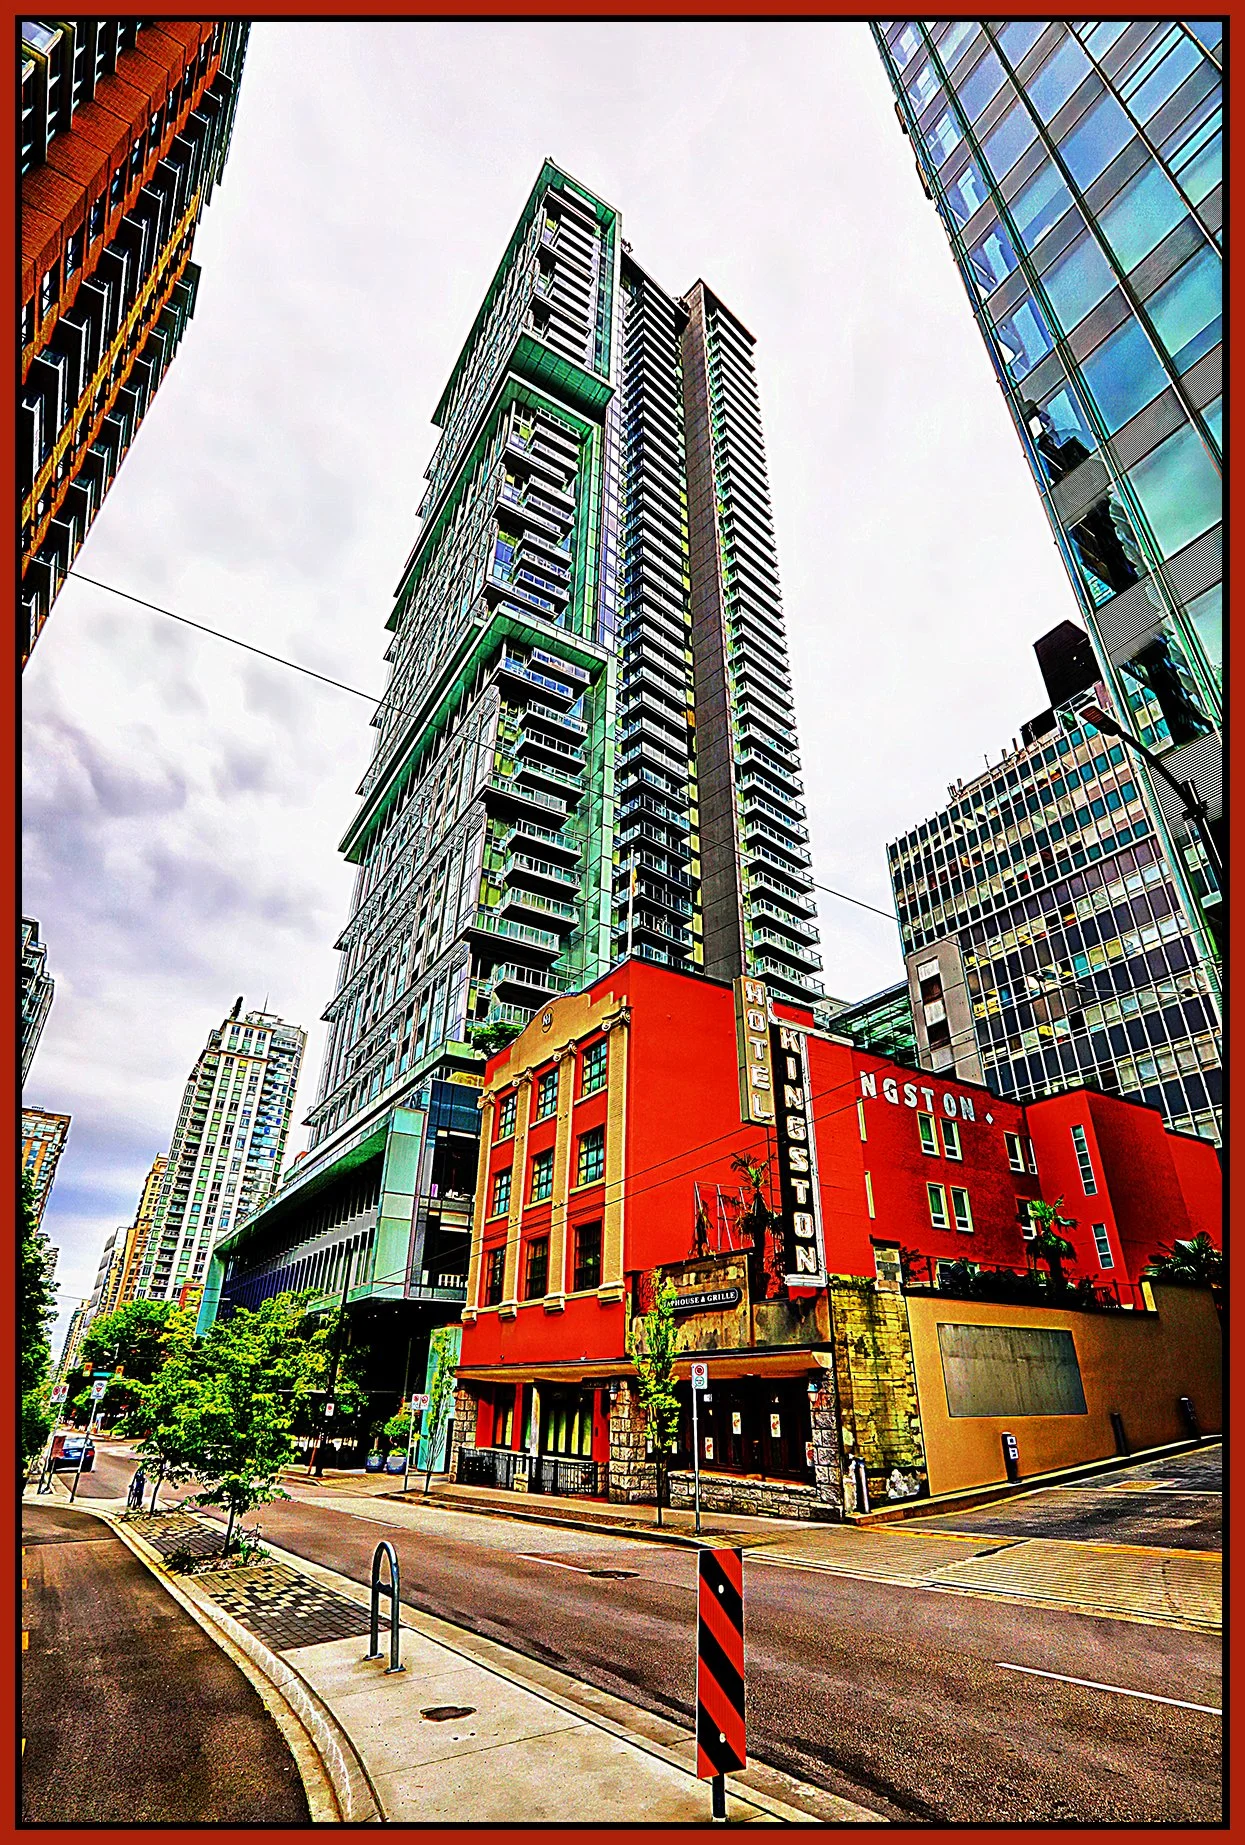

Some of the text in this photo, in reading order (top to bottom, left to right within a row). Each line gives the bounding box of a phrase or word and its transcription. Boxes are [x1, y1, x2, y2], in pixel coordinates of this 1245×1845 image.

[745, 980, 775, 1120] HOTEL
[859, 1070, 976, 1122] NGSTON
[780, 1026, 818, 1274] KINGSTON
[707, 1291, 736, 1303] GRILLE
